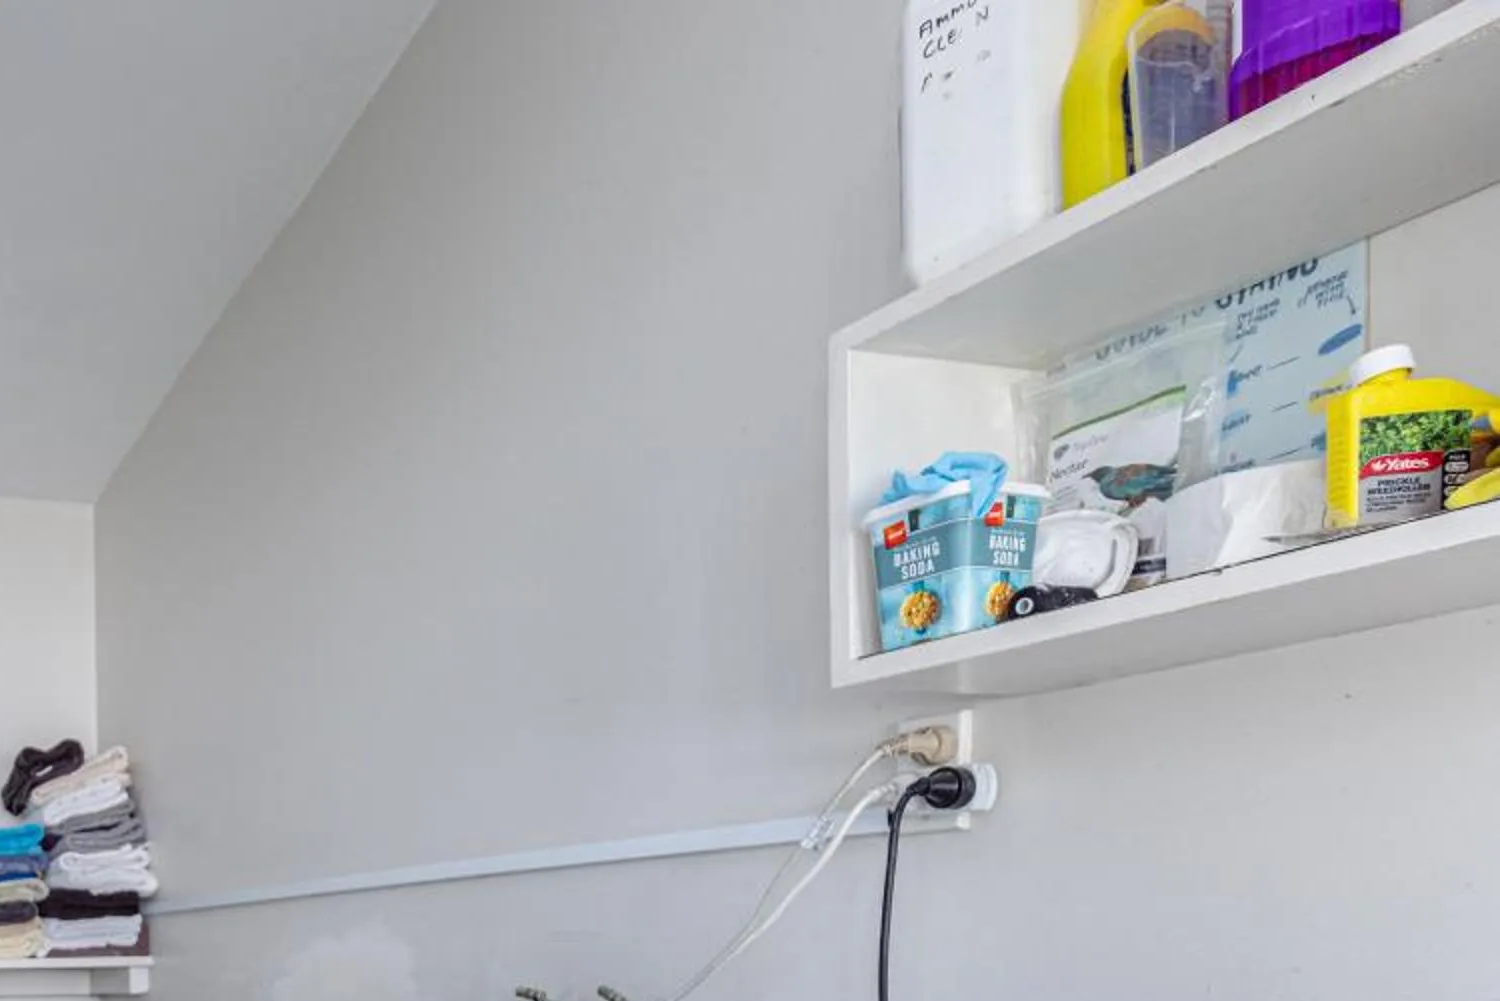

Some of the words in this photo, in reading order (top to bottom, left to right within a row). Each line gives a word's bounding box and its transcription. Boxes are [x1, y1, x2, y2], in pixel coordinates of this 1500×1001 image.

[1386, 457, 1430, 471] Yates
[988, 534, 1027, 552] BAKING
[892, 540, 941, 567] BAKING
[992, 551, 1020, 567] SODA
[900, 558, 936, 580] SODA
